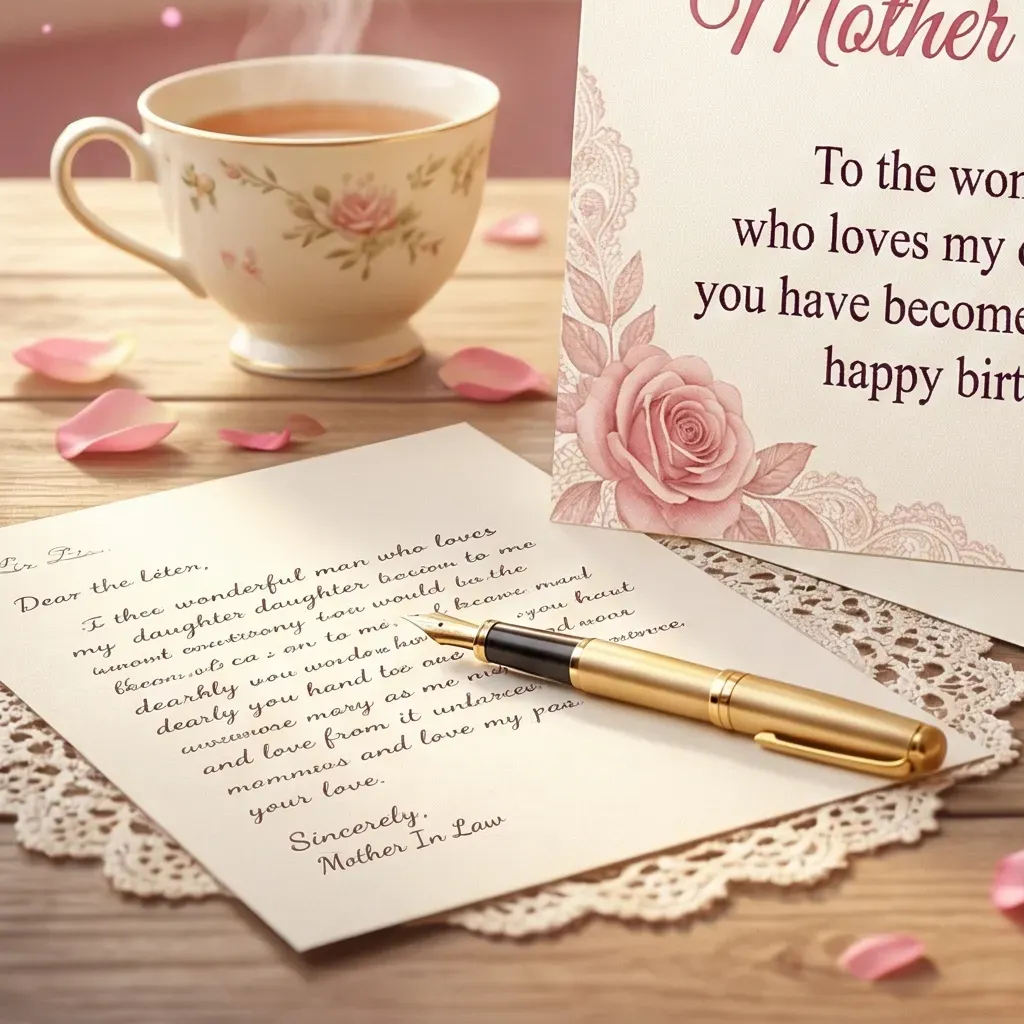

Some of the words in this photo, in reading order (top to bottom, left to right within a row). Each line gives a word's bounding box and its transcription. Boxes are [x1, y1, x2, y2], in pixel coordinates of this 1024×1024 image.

[813, 144, 864, 188] To
[876, 148, 937, 194] the
[731, 206, 816, 252] who
[828, 211, 930, 261] loves
[941, 226, 1006, 277] my
[692, 280, 767, 321] you
[777, 274, 871, 323] have
[822, 344, 944, 407] happy
[12, 591, 81, 614] Dear
[89, 577, 135, 594] the
[174, 567, 306, 616] wonderful
[314, 559, 370, 577] man
[377, 543, 428, 562] who
[434, 527, 497, 548] loves
[371, 579, 446, 609] would
[72, 643, 116, 659] my
[132, 611, 245, 644] daughter
[254, 582, 370, 615] daughter
[464, 550, 490, 563] to
[324, 631, 351, 643] to
[156, 697, 239, 736] dearly
[248, 694, 299, 719] you
[306, 668, 373, 697] hand
[384, 689, 415, 703] as
[421, 678, 460, 693] me
[202, 747, 255, 775] and
[262, 739, 317, 760] love
[323, 723, 390, 750] from
[399, 708, 422, 725] it
[360, 734, 413, 761] and
[419, 725, 475, 745] love
[483, 714, 523, 731] my
[248, 794, 313, 825] your
[316, 843, 408, 876] Mother
[408, 828, 447, 850] In
[451, 815, 506, 839] Law
